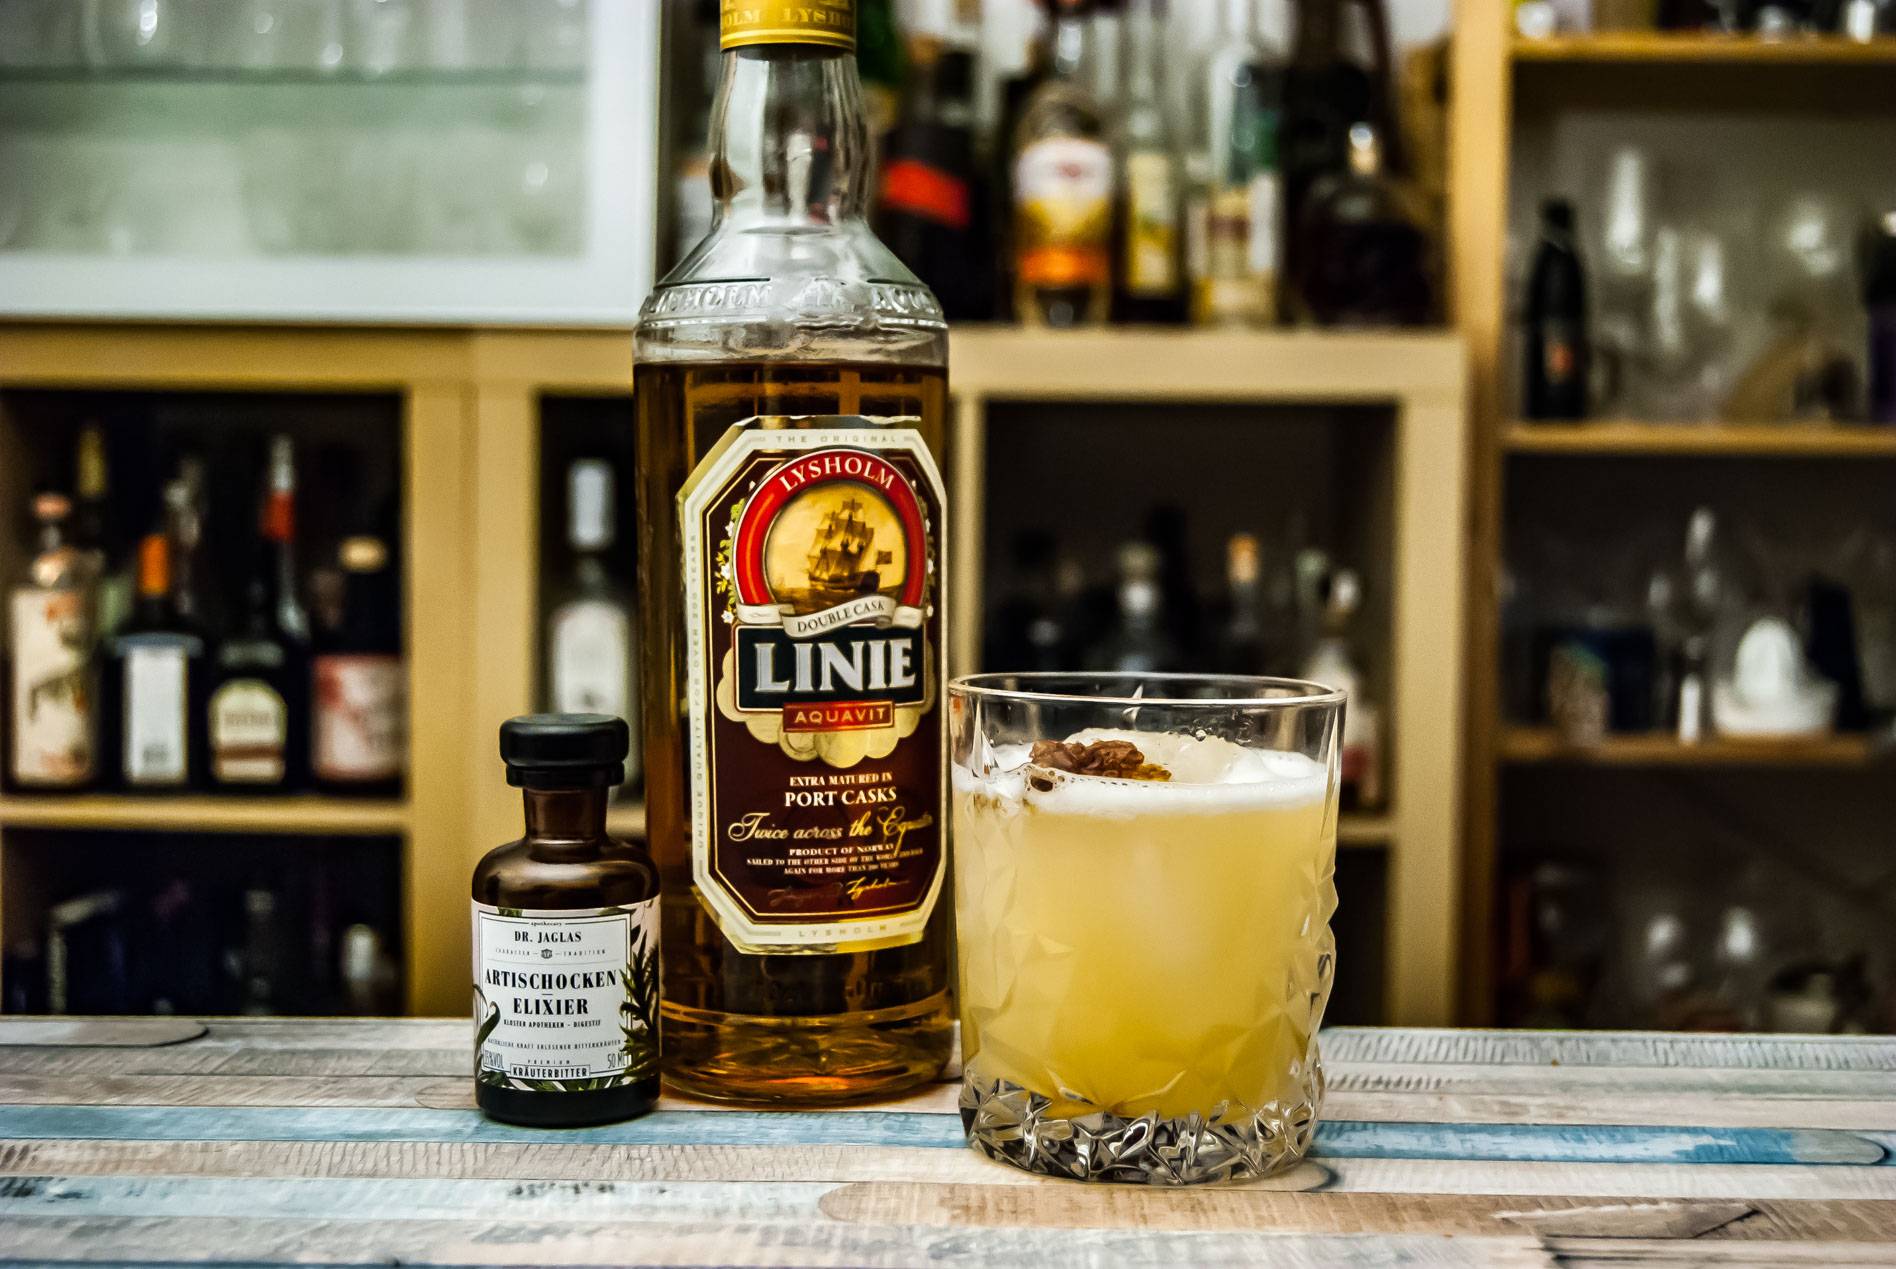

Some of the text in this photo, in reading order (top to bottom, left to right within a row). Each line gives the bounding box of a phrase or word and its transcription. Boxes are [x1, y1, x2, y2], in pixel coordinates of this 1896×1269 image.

[776, 434, 896, 443] THE ORIGINAL
[779, 456, 895, 492] LYSHOLM
[797, 601, 886, 633] DOUBLE CASK
[692, 628, 700, 668] OVER
[754, 638, 916, 693] LINIE
[794, 707, 886, 724] AQUAVIT
[695, 717, 703, 780] QUALITY
[789, 771, 894, 787] EXTRA MATURED IN
[784, 786, 898, 807] PORT CASKS
[696, 790, 704, 849] UNIQUE
[727, 812, 790, 842] Twice
[792, 825, 844, 840] across
[848, 811, 874, 838] the
[789, 847, 839, 857] PRODUCT
[840, 846, 854, 855] OF
[856, 843, 895, 853] NORWAY
[745, 858, 775, 866] SAILED
[775, 858, 786, 866] TO
[787, 858, 802, 866] THE
[514, 930, 582, 944] DR. JAGLAS
[798, 924, 887, 938] LYSHOLM
[485, 968, 617, 990] ARTISCHOCKEN
[513, 997, 589, 1015] ELIXIER
[607, 1053, 616, 1069] 50
[513, 1066, 587, 1079] KRÄUTERBITTER
